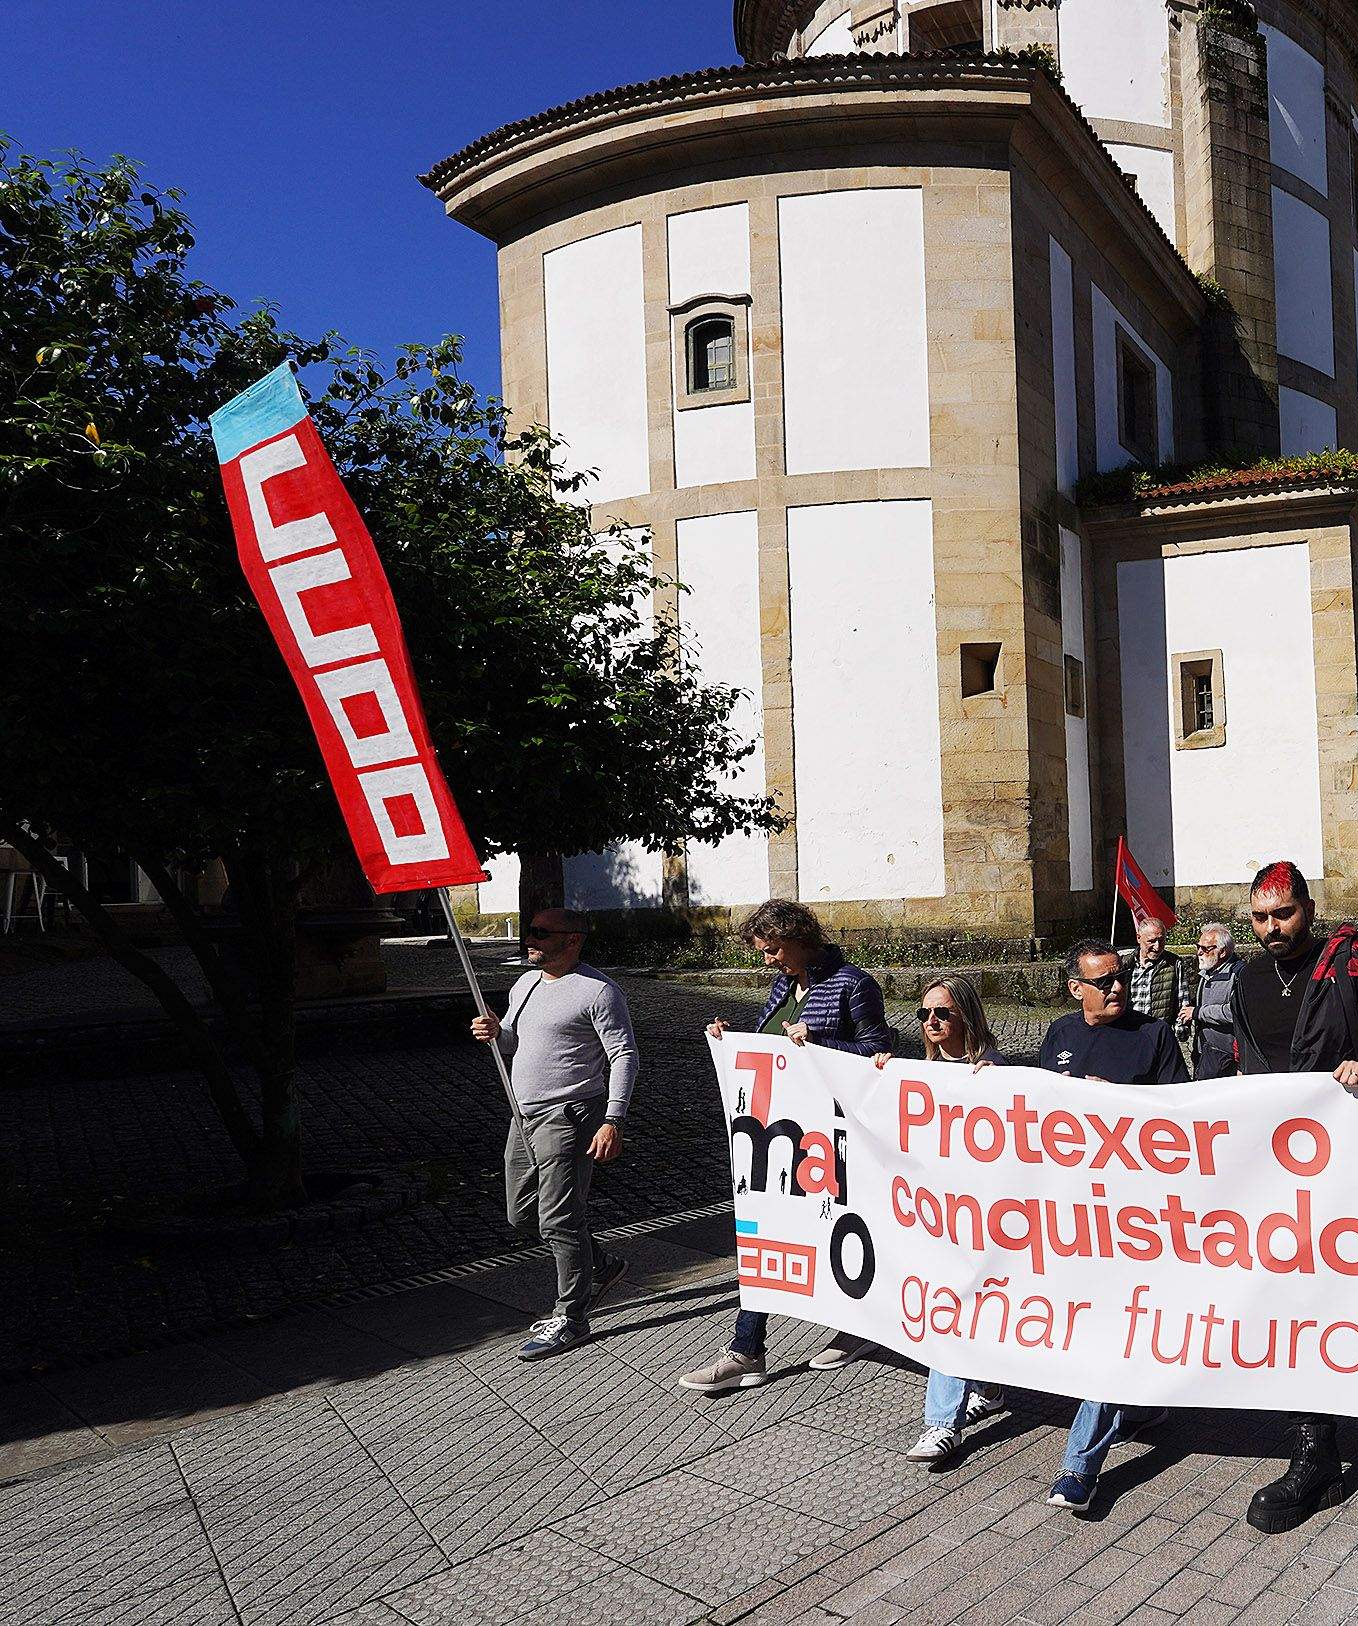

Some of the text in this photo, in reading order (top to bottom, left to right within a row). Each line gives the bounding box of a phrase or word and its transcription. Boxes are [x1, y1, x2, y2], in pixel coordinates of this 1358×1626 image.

[239, 434, 451, 866] CCOO
[899, 1080, 1332, 1177] Protexer o
[902, 1276, 1092, 1350] gañar
